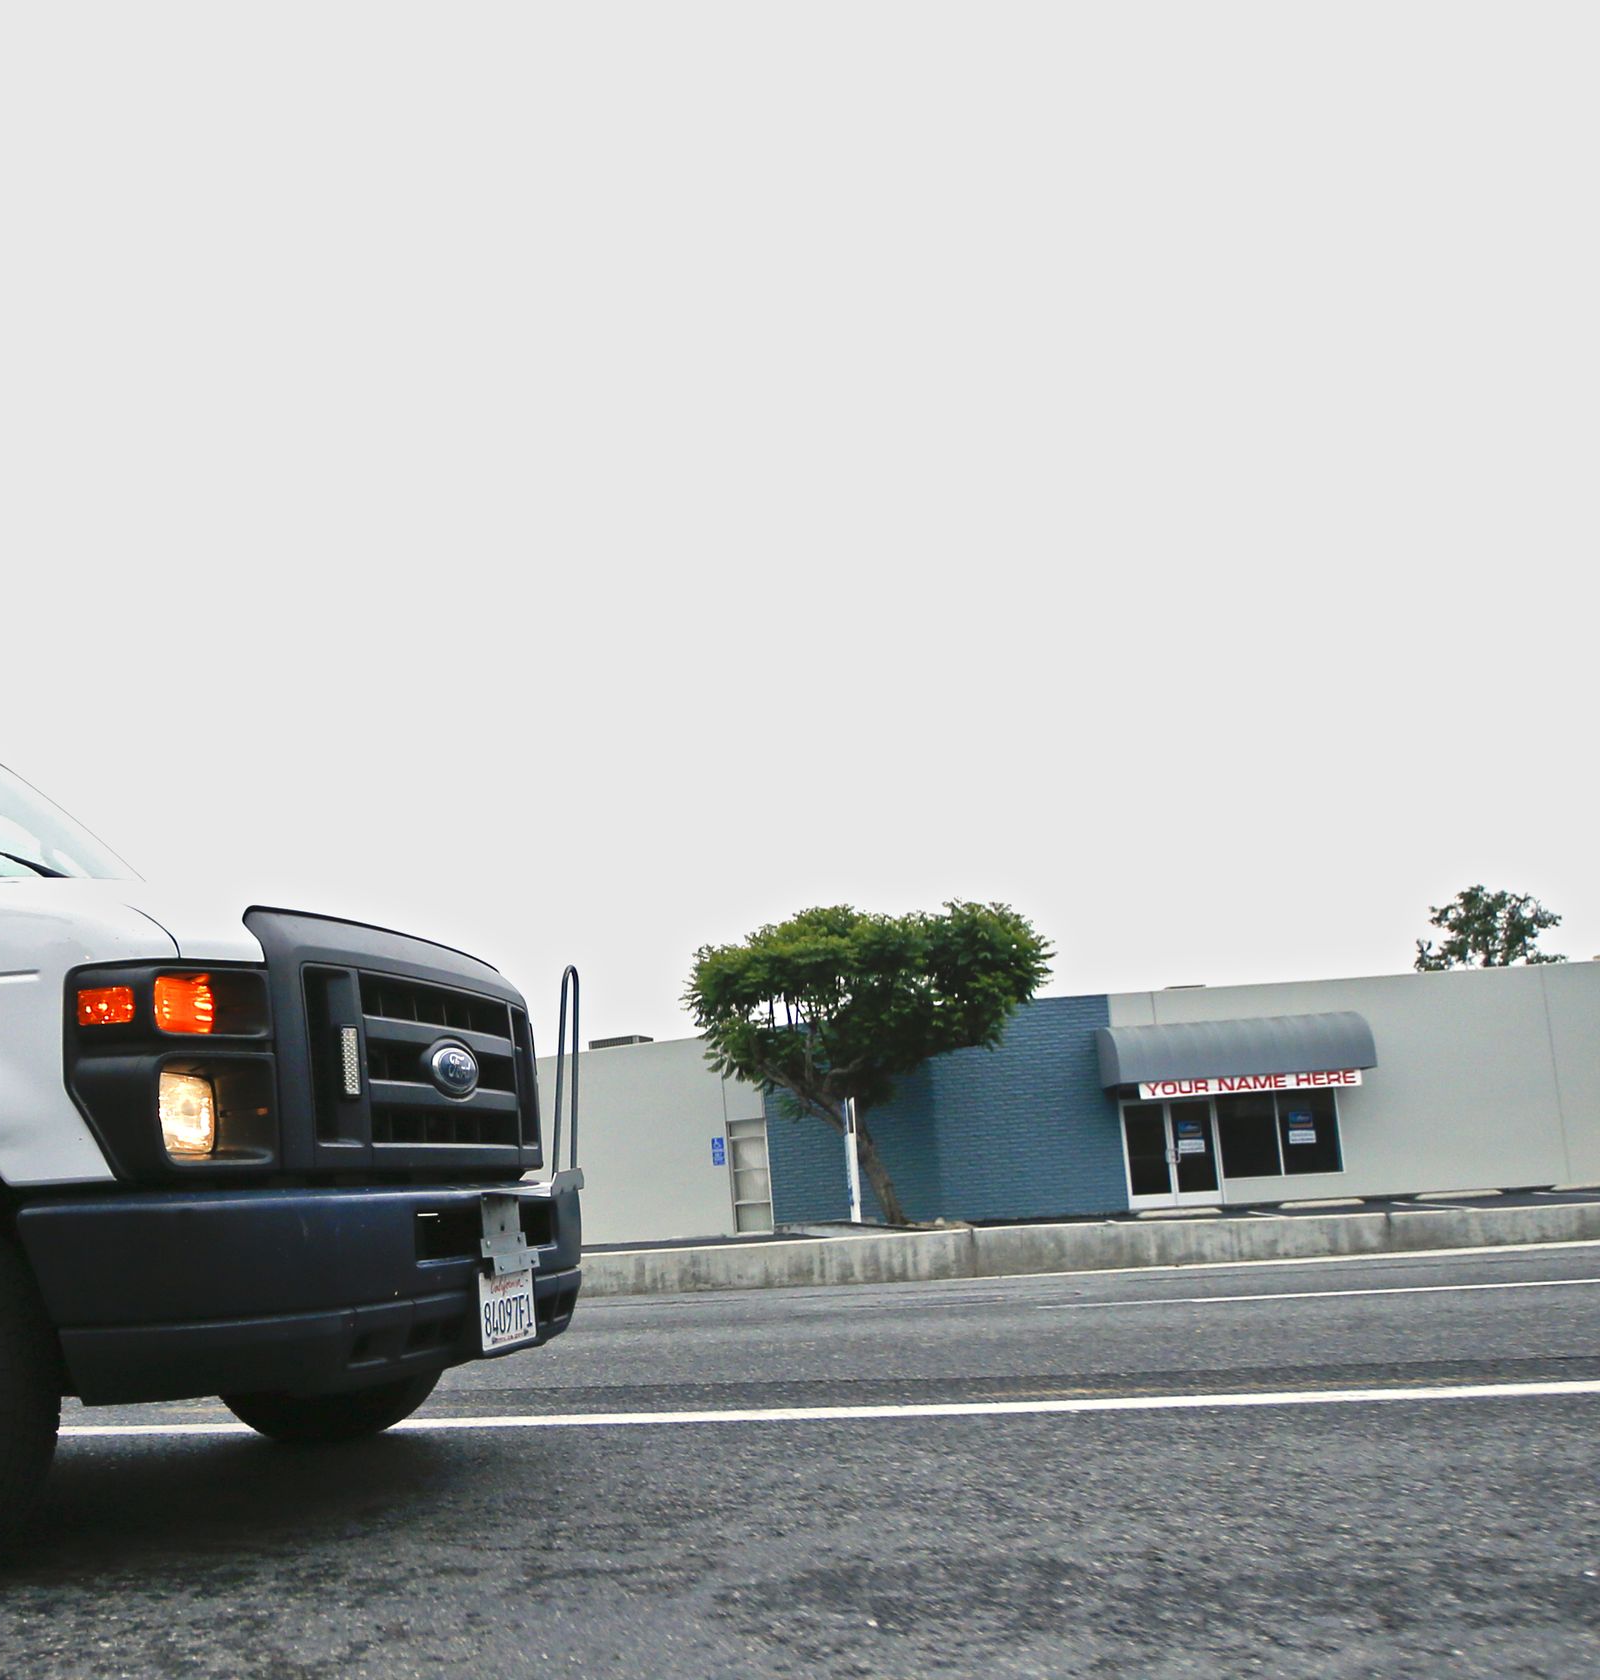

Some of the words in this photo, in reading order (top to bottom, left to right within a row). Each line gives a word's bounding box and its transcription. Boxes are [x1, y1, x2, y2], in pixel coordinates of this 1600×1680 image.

[1146, 1079, 1209, 1097] YOUR
[1218, 1073, 1288, 1092] NAME
[1296, 1069, 1357, 1087] HERE
[484, 1294, 533, 1337] 84097F1
